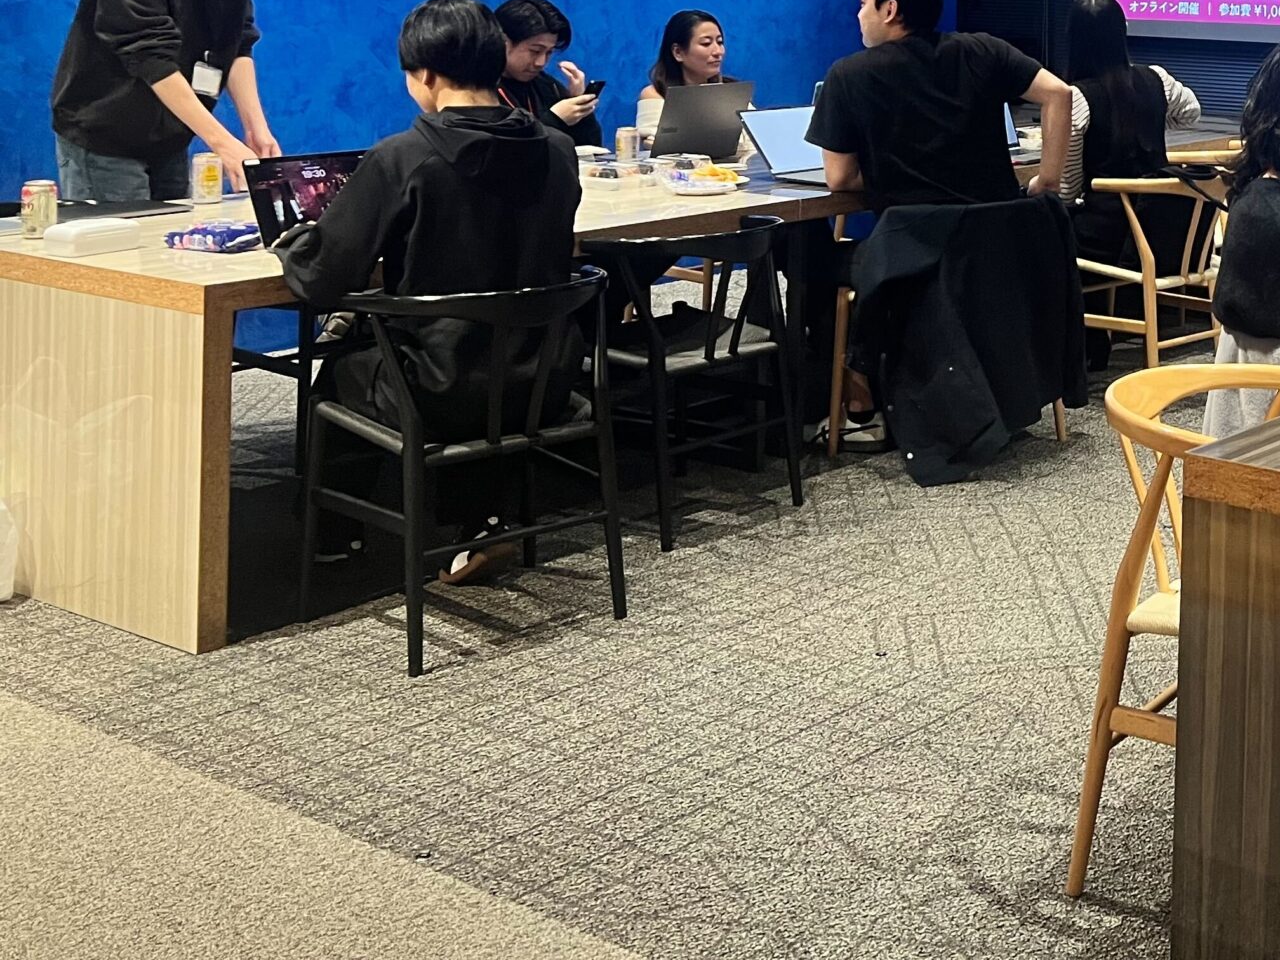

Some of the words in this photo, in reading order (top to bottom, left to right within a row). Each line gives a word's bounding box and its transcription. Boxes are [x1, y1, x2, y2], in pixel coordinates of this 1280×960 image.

[1129, 1, 1199, 16] オフライン開催
[1219, 3, 1252, 17] 参加費
